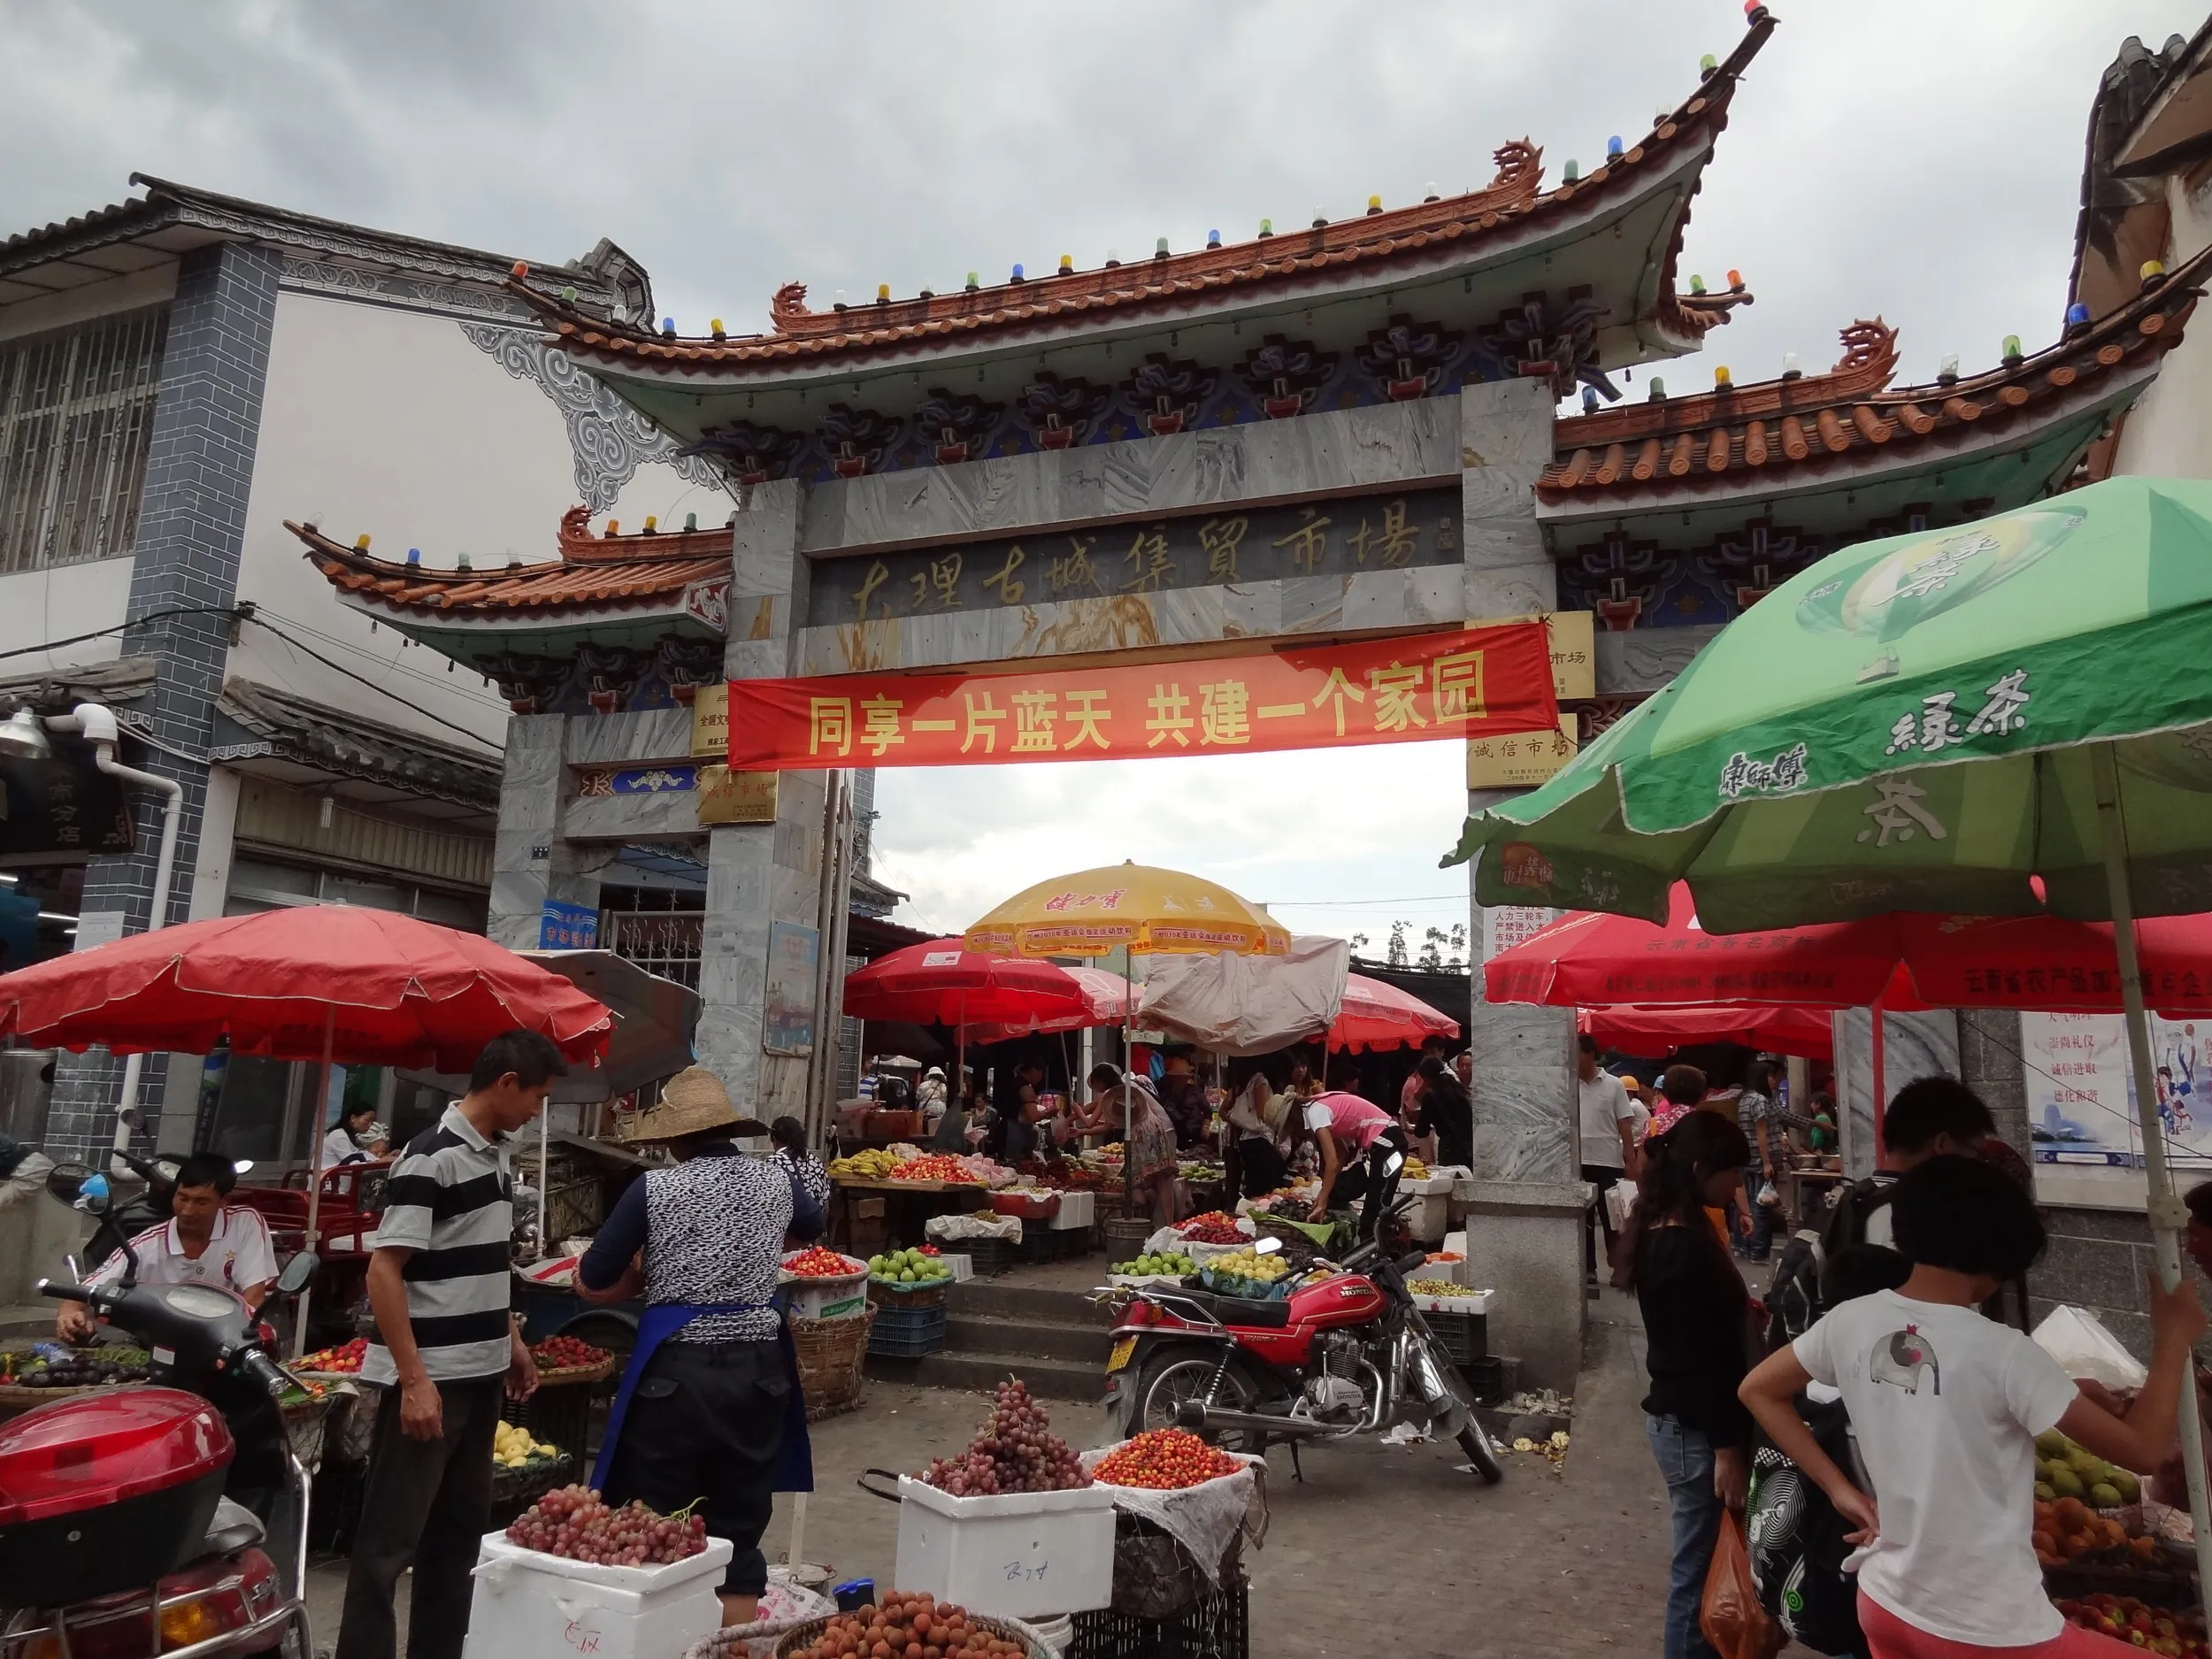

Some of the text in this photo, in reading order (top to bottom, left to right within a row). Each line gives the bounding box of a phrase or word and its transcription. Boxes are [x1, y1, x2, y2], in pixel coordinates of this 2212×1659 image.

[809, 649, 1487, 755] 同享一片蓝天 共建一个家园
[2048, 1035, 2094, 1049] 崇尚礼仪
[2051, 1063, 2097, 1076] 诚信进取
[2054, 1089, 2099, 1103] 德化和谐
